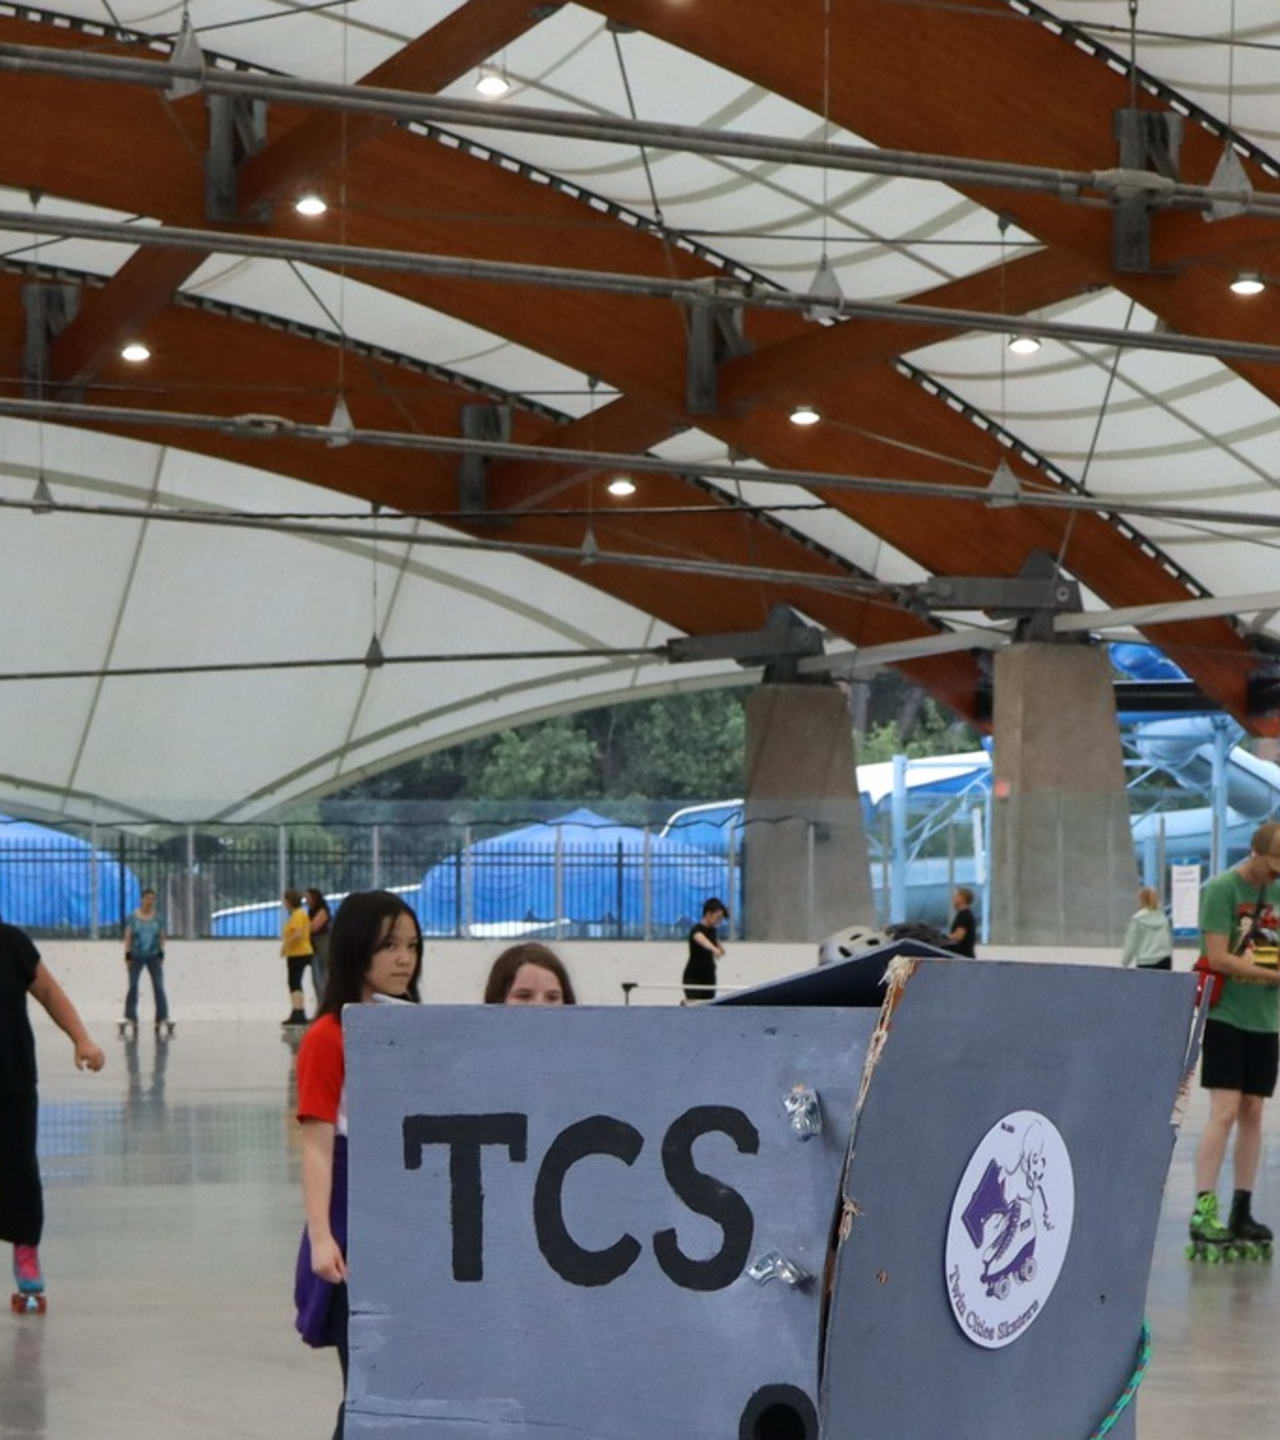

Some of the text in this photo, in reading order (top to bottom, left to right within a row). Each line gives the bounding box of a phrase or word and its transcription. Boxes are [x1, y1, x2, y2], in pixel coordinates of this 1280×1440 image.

[402, 1104, 761, 1292] TCS
[949, 1264, 1040, 1341] Twin Cities Skaters
